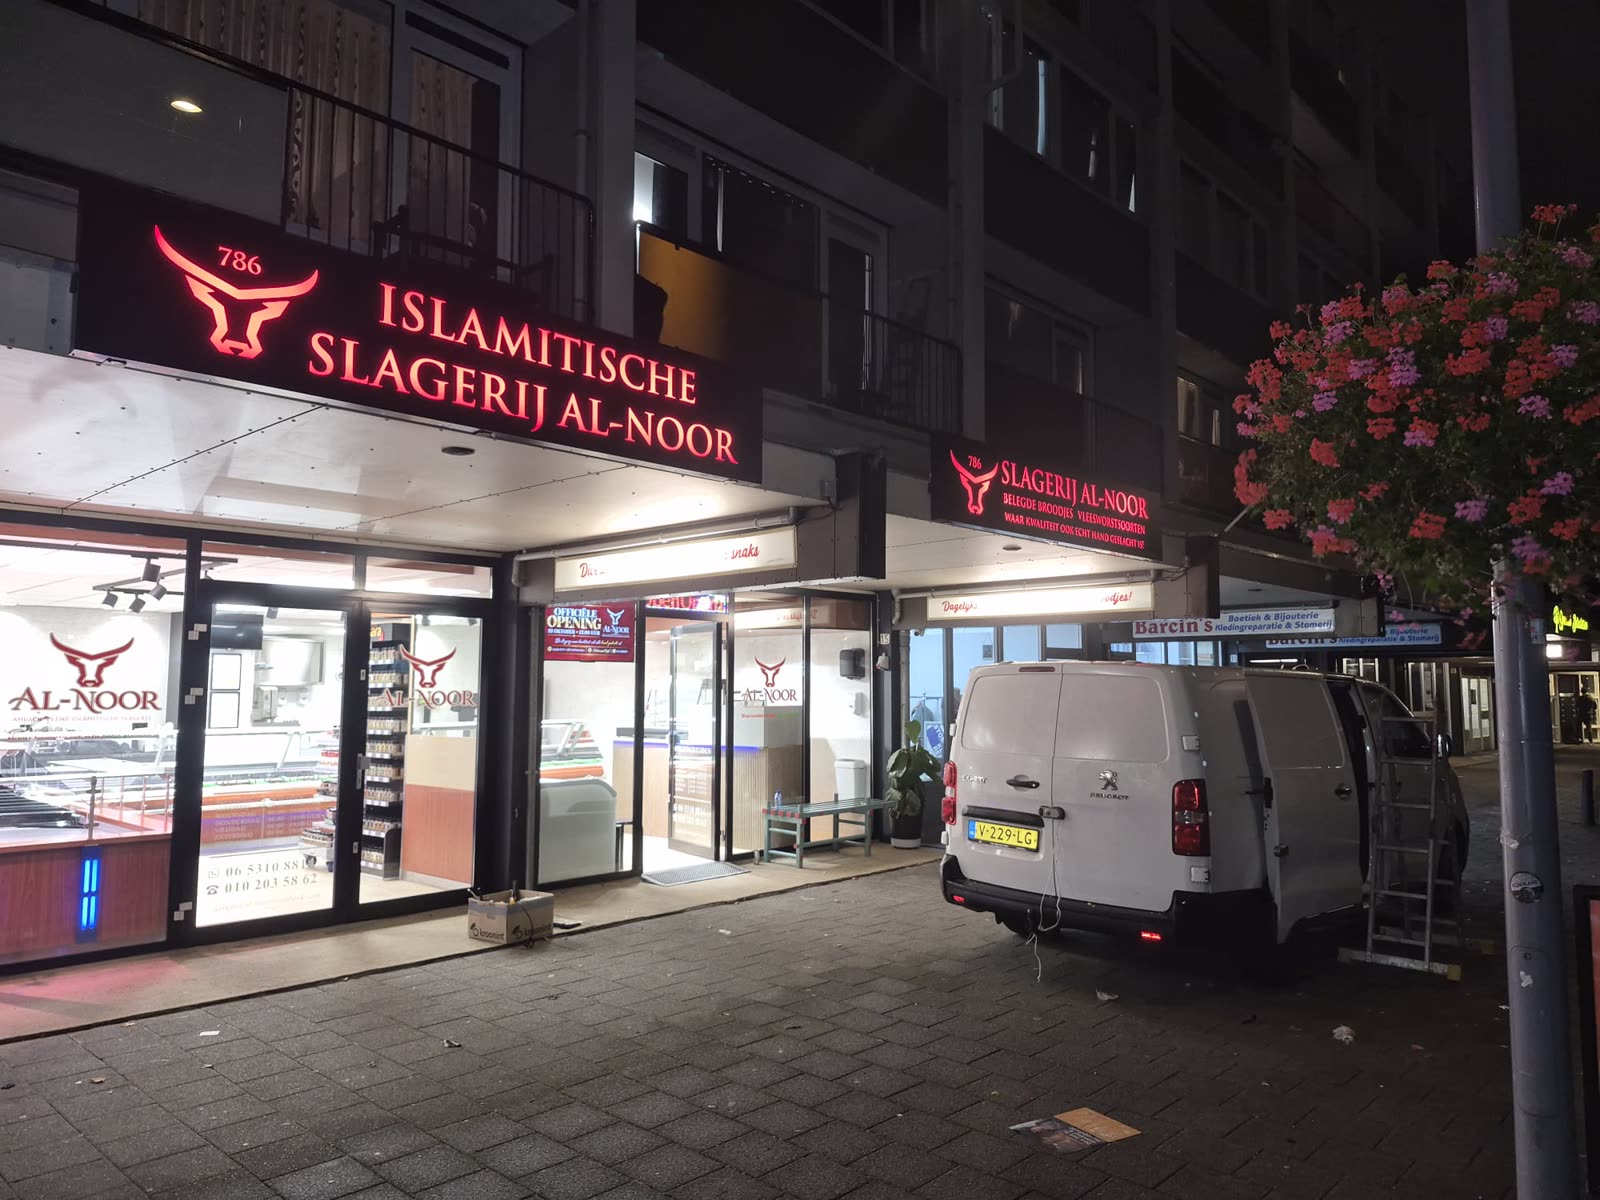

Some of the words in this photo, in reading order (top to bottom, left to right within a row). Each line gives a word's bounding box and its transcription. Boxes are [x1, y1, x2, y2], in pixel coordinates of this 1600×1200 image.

[217, 245, 262, 276] 786
[379, 281, 697, 406] ISLAMITISCHE
[308, 331, 547, 433] SLAGERIJ
[558, 395, 740, 466] AL-NOOR
[967, 455, 982, 469] 786
[1001, 460, 1077, 507] SLAGERIJ
[1080, 481, 1149, 520] AL-NOOR
[1003, 492, 1037, 511] BELEGDE
[1037, 500, 1074, 519] BROODJES
[1004, 511, 1025, 525] WAAR
[1025, 516, 1060, 533] KWALITEIT
[1060, 523, 1075, 536] OOK
[1075, 526, 1091, 539] ECHT
[1091, 530, 1110, 543] HAND
[1109, 533, 1137, 549] GESLACHT
[730, 544, 760, 561] snaks
[553, 607, 598, 618] OFFICIËLE
[1228, 612, 1262, 623] Boetiek
[1264, 612, 1271, 621] &
[1274, 610, 1320, 622] Bijouterie
[546, 615, 602, 631] OPENING
[603, 625, 630, 636] AL-NOOR
[1135, 618, 1213, 635] Barcin's
[1214, 620, 1283, 633] Kledingreparatie
[1284, 621, 1292, 630] &
[1294, 619, 1333, 631] Stomerij
[880, 635, 890, 645] 15
[1398, 634, 1406, 642] &
[1407, 633, 1440, 643] Stomerij
[7, 686, 163, 714] AL-NOOR
[378, 688, 478, 710] AL-NOOR
[741, 687, 798, 704] AL-NOOR
[979, 824, 1032, 845] V-229-LG
[225, 866, 242, 877] 06
[247, 863, 279, 875] 5310
[283, 859, 315, 870] 881
[224, 881, 250, 894] 010
[255, 877, 278, 889] 203
[283, 875, 298, 886] 58
[302, 873, 318, 885] 62
